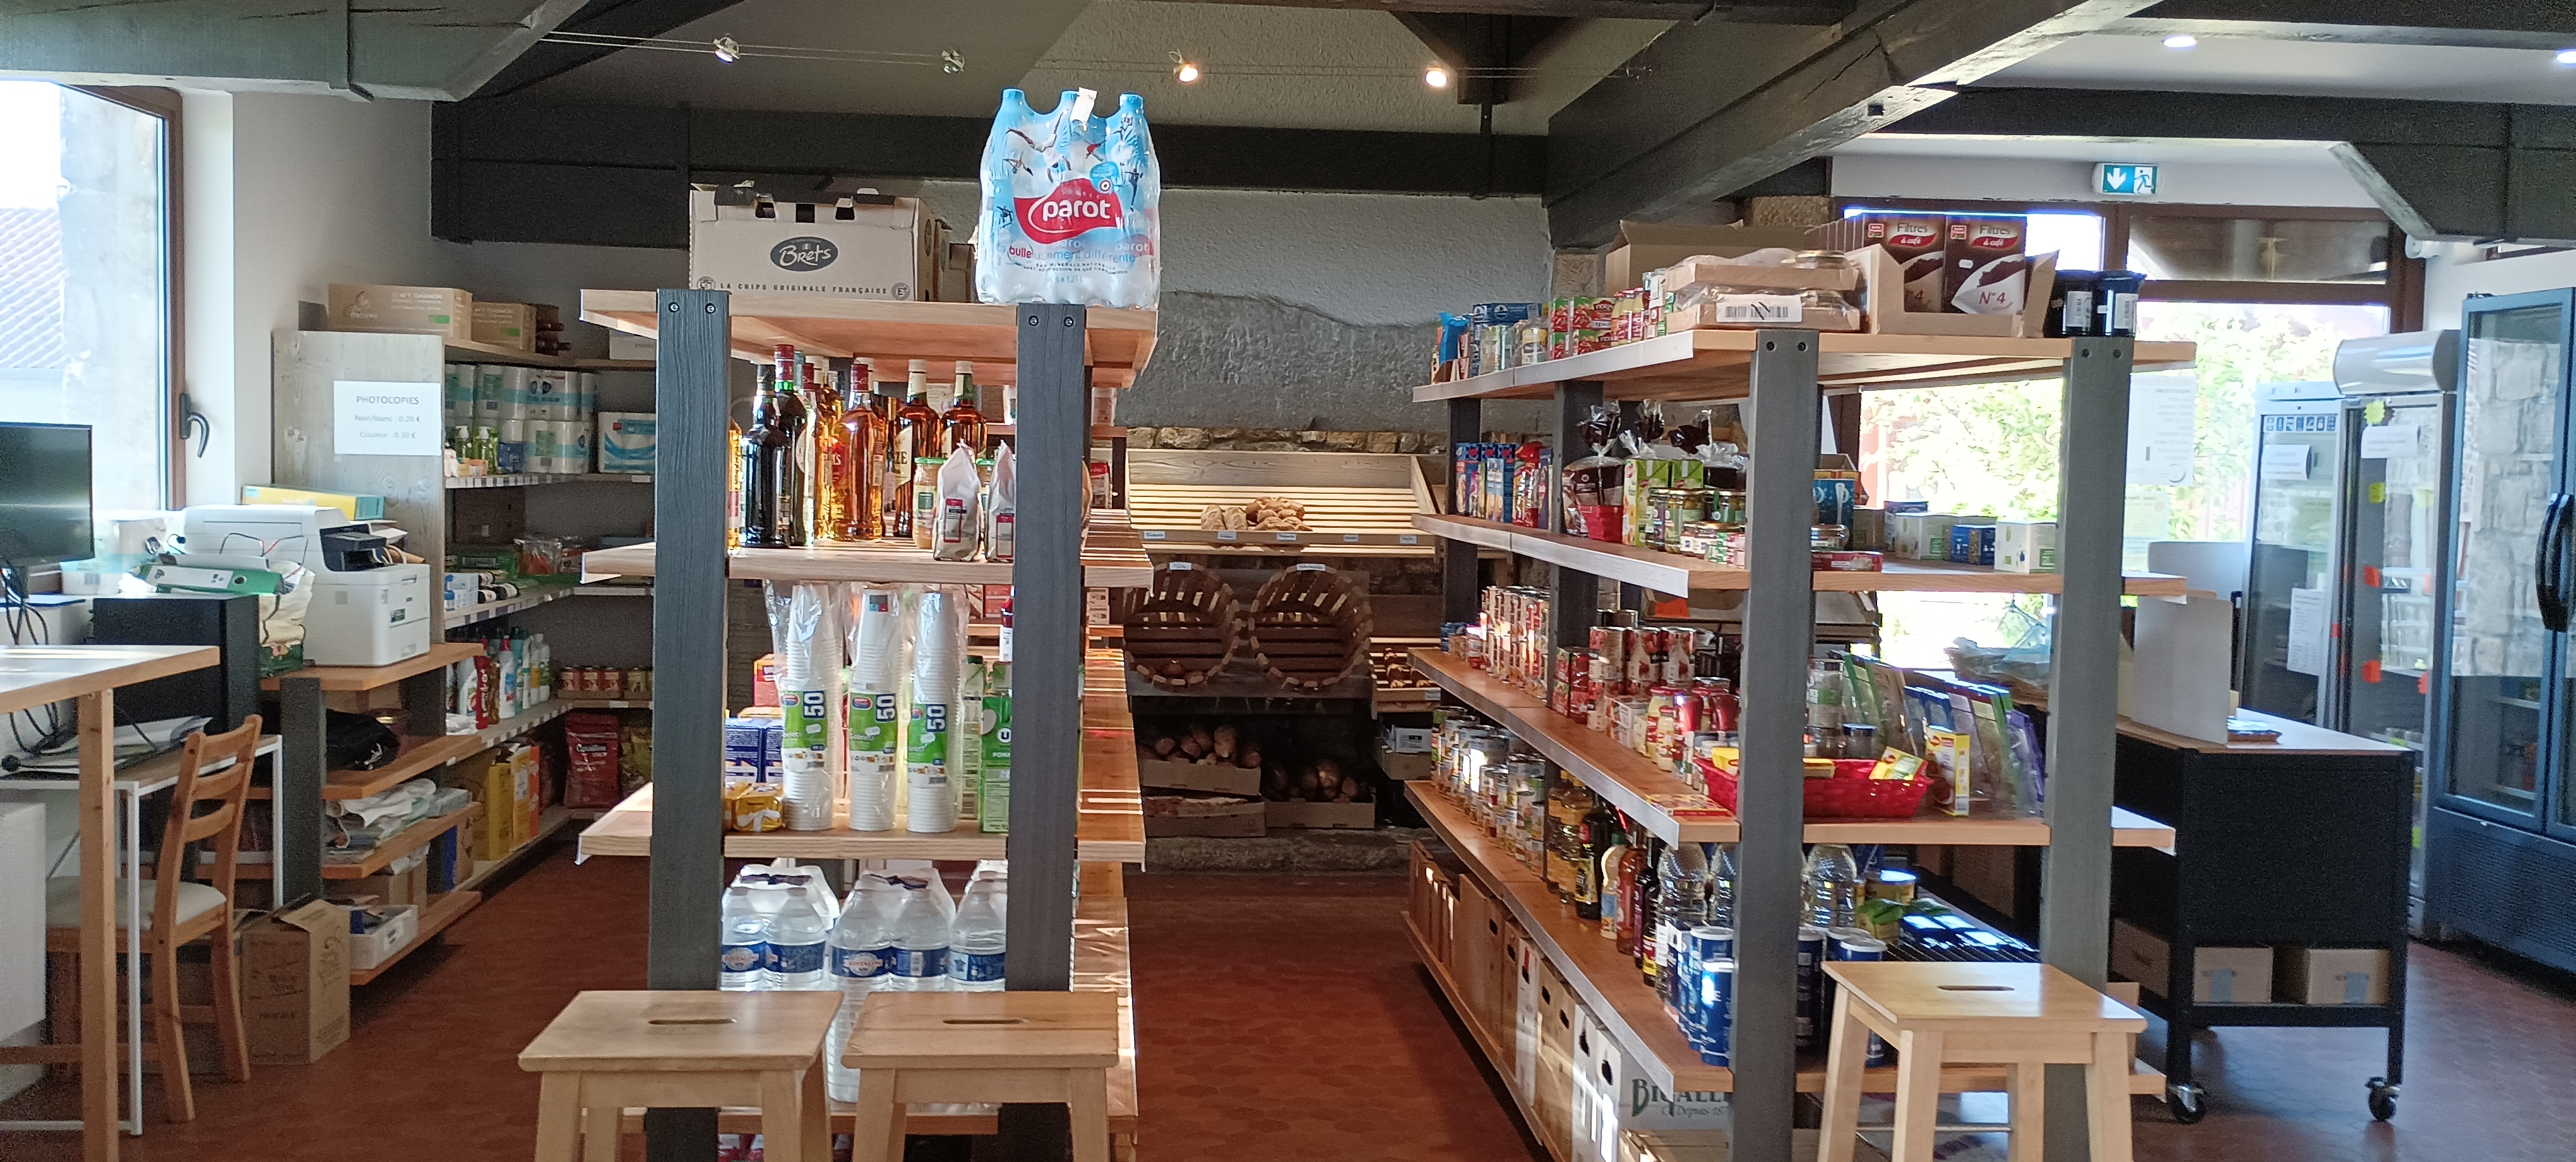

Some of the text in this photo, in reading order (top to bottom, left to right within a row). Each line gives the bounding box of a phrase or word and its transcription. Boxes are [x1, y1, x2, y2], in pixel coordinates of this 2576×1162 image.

[1042, 200, 1111, 222] parot
[1897, 222, 1928, 233] Filtres
[1979, 224, 2011, 235] Filtres
[778, 244, 832, 267] Brets
[737, 283, 767, 291] CHIPS
[773, 284, 826, 292] ORIGINALE
[833, 285, 887, 295] FRANÇAISE
[356, 396, 419, 405] PHOTOCOPIES
[804, 692, 825, 717] 50
[876, 695, 895, 721] 50
[927, 705, 946, 731] 50
